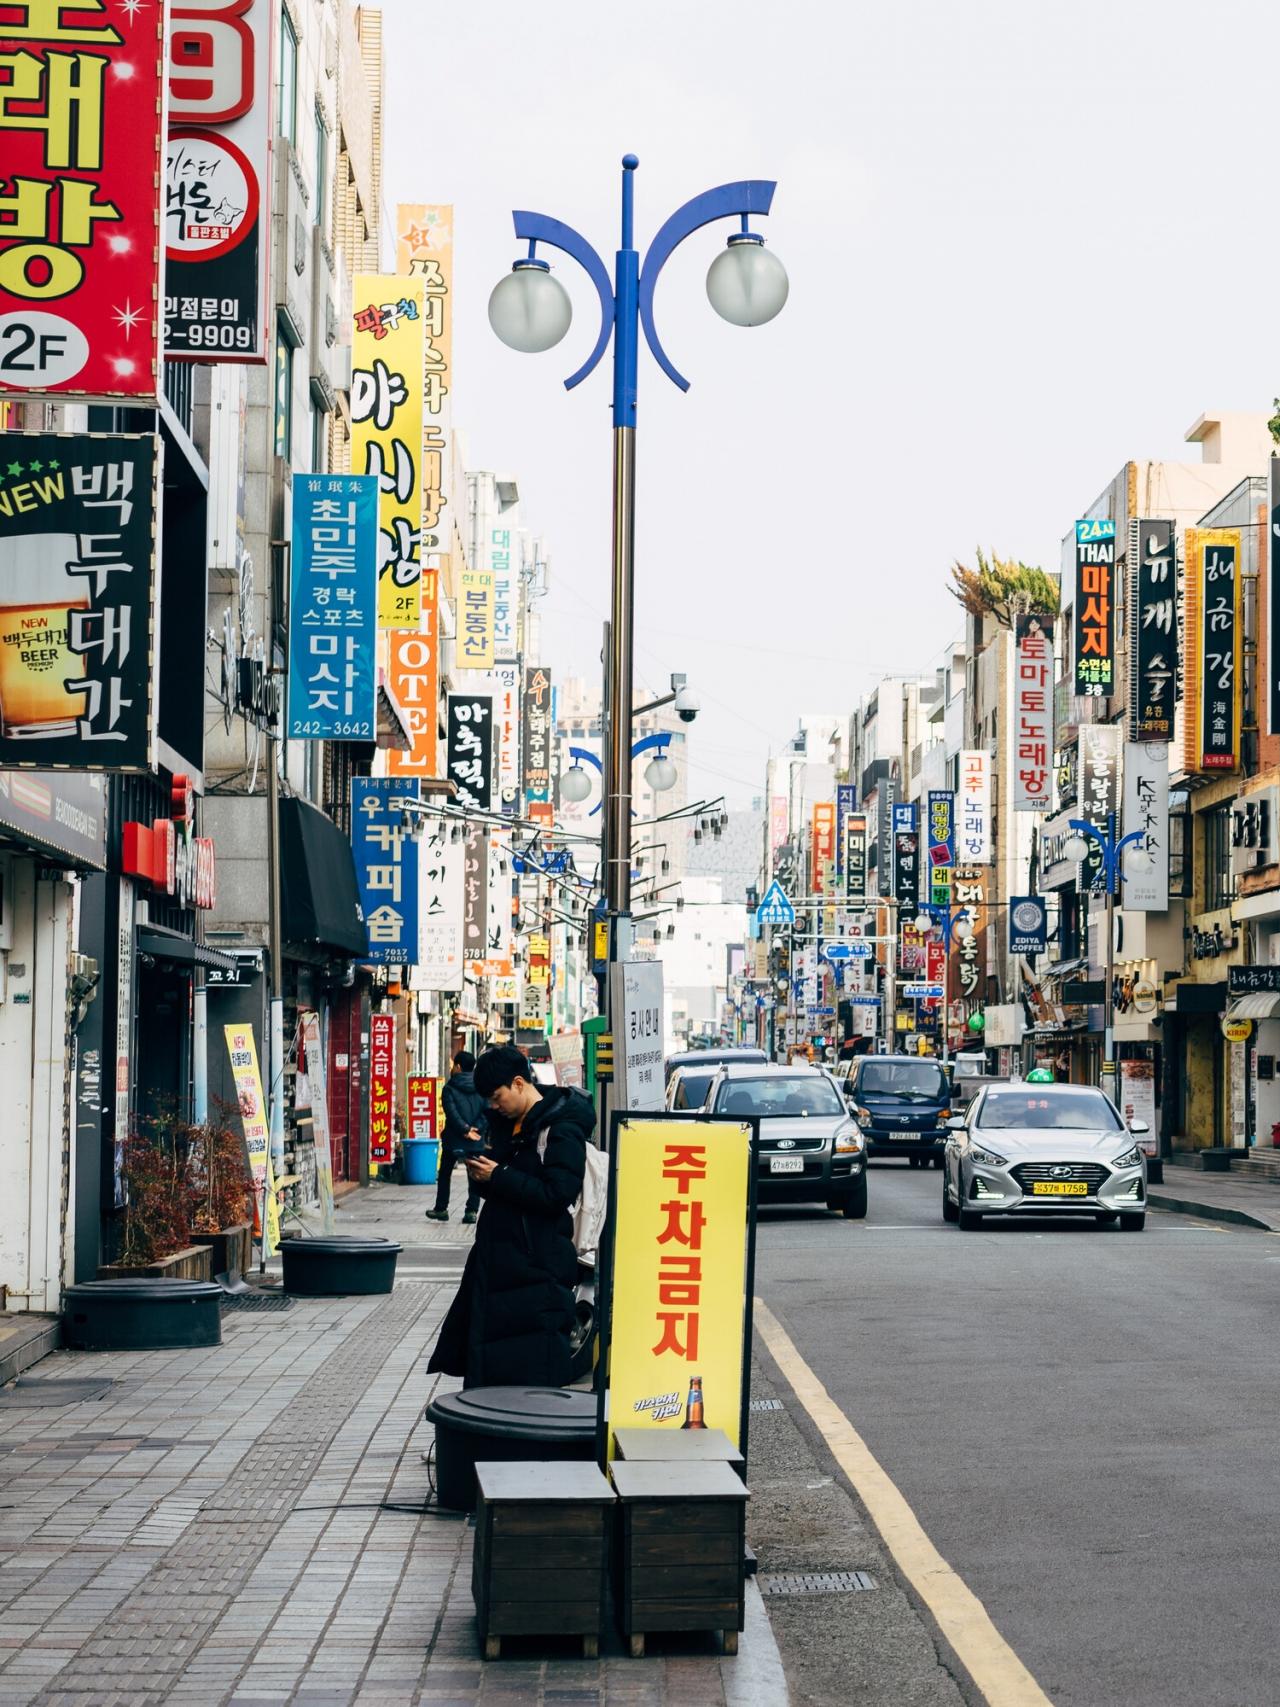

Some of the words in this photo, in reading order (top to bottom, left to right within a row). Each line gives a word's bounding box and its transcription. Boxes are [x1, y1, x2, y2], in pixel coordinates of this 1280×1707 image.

[2, 322, 68, 372] 2F
[0, 472, 66, 520] NEW
[309, 500, 357, 580] 최민주
[1078, 544, 1114, 563] THAI
[66, 460, 135, 742] 백두대간
[302, 609, 364, 627] 스포츠
[312, 587, 357, 606] 경락
[395, 597, 415, 610] 2F
[1081, 566, 1110, 656] 마사지
[3, 628, 68, 648] 백두대간
[21, 617, 48, 629] NEW
[464, 591, 490, 657] 부동산
[1205, 551, 1234, 690] 해금강
[20, 648, 59, 663] BEER
[308, 636, 360, 716] 마사지
[293, 720, 370, 736] 242-3642
[528, 703, 547, 768] 노래주점
[1211, 701, 1227, 745] 海金剛
[965, 757, 984, 792] 고추
[965, 798, 984, 855] 노래방
[365, 825, 404, 943] 커피숍
[1011, 945, 1043, 953] COFFEE
[1015, 937, 1040, 945] EDIYA
[208, 969, 241, 982] 꼬치
[1231, 970, 1275, 987] 해금강
[631, 1007, 659, 1040] 공사안내
[373, 1021, 391, 1078] 쓰리스타
[410, 1082, 432, 1095] 우리
[373, 1081, 392, 1144] 노래방
[411, 1096, 432, 1139] 모텔
[652, 1145, 707, 1362] 주차금지
